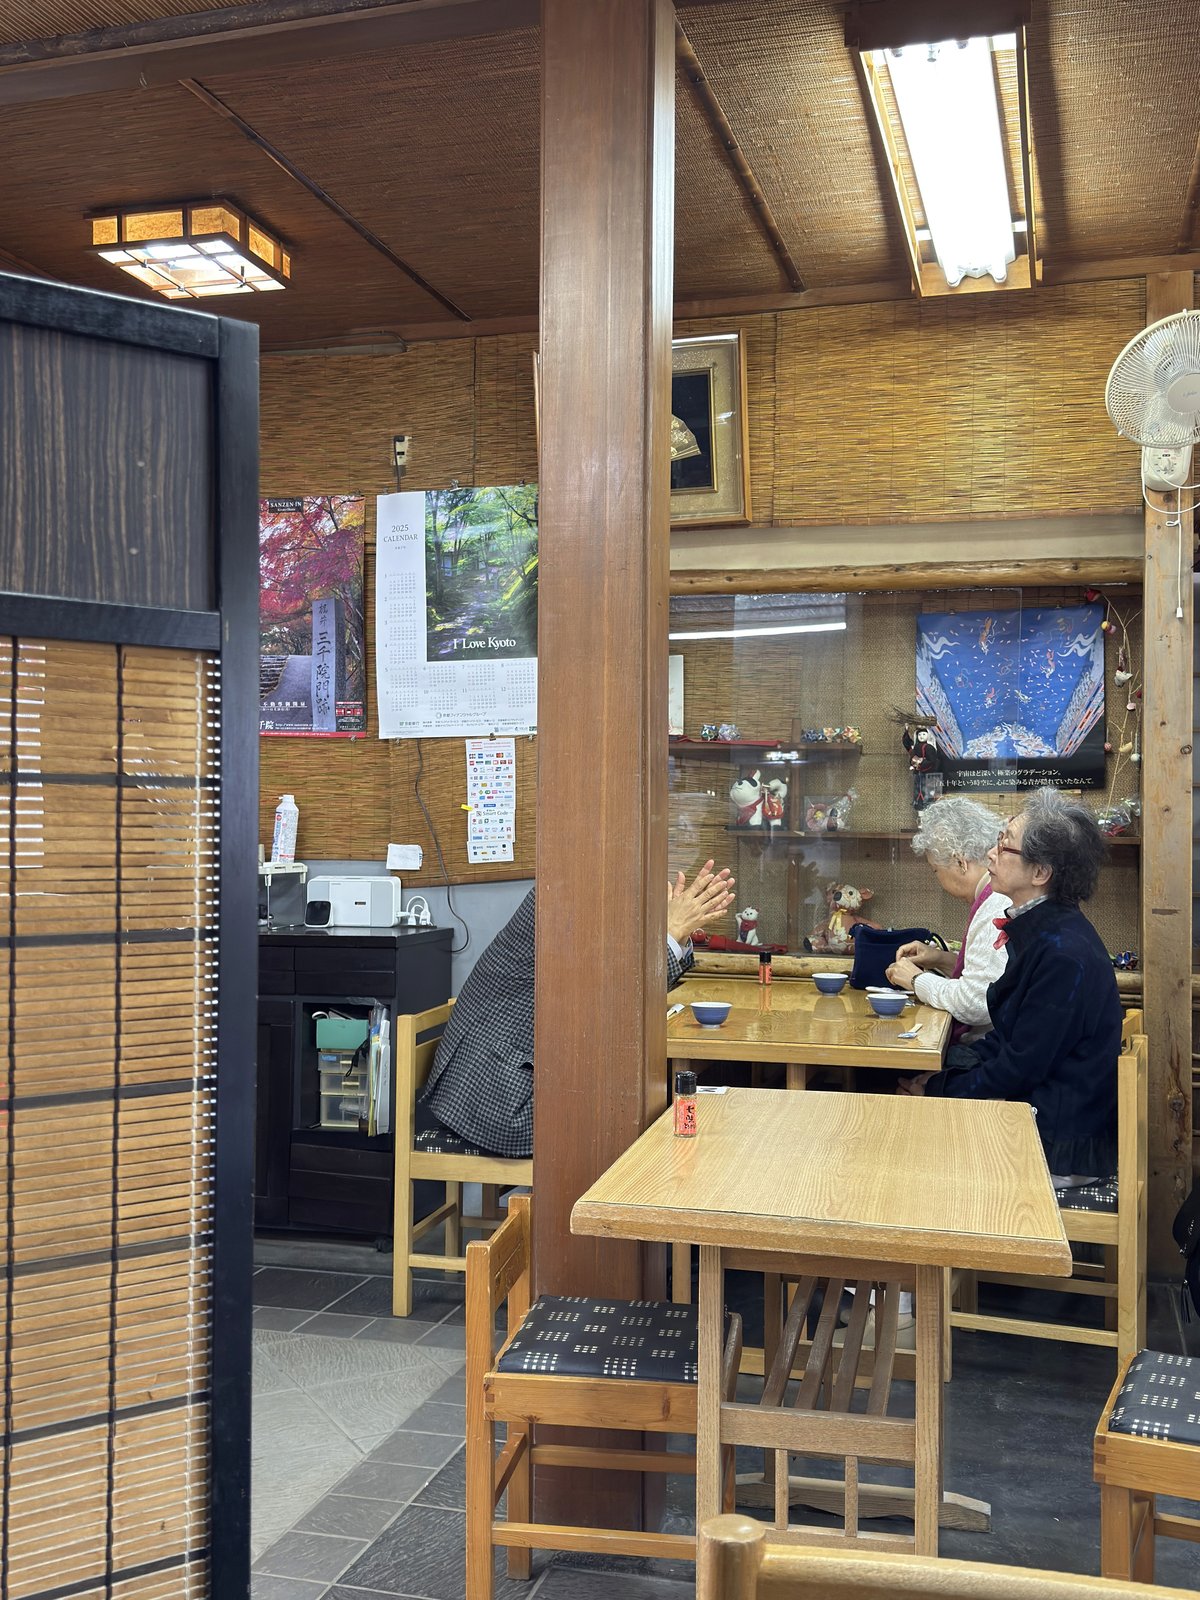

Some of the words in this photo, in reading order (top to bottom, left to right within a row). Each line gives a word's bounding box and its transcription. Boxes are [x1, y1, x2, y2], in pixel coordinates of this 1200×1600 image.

[391, 523, 409, 533] 2025
[383, 533, 418, 543] CALENDAR
[453, 638, 458, 650] I
[462, 637, 486, 649] Love
[488, 636, 516, 651] Kyoto
